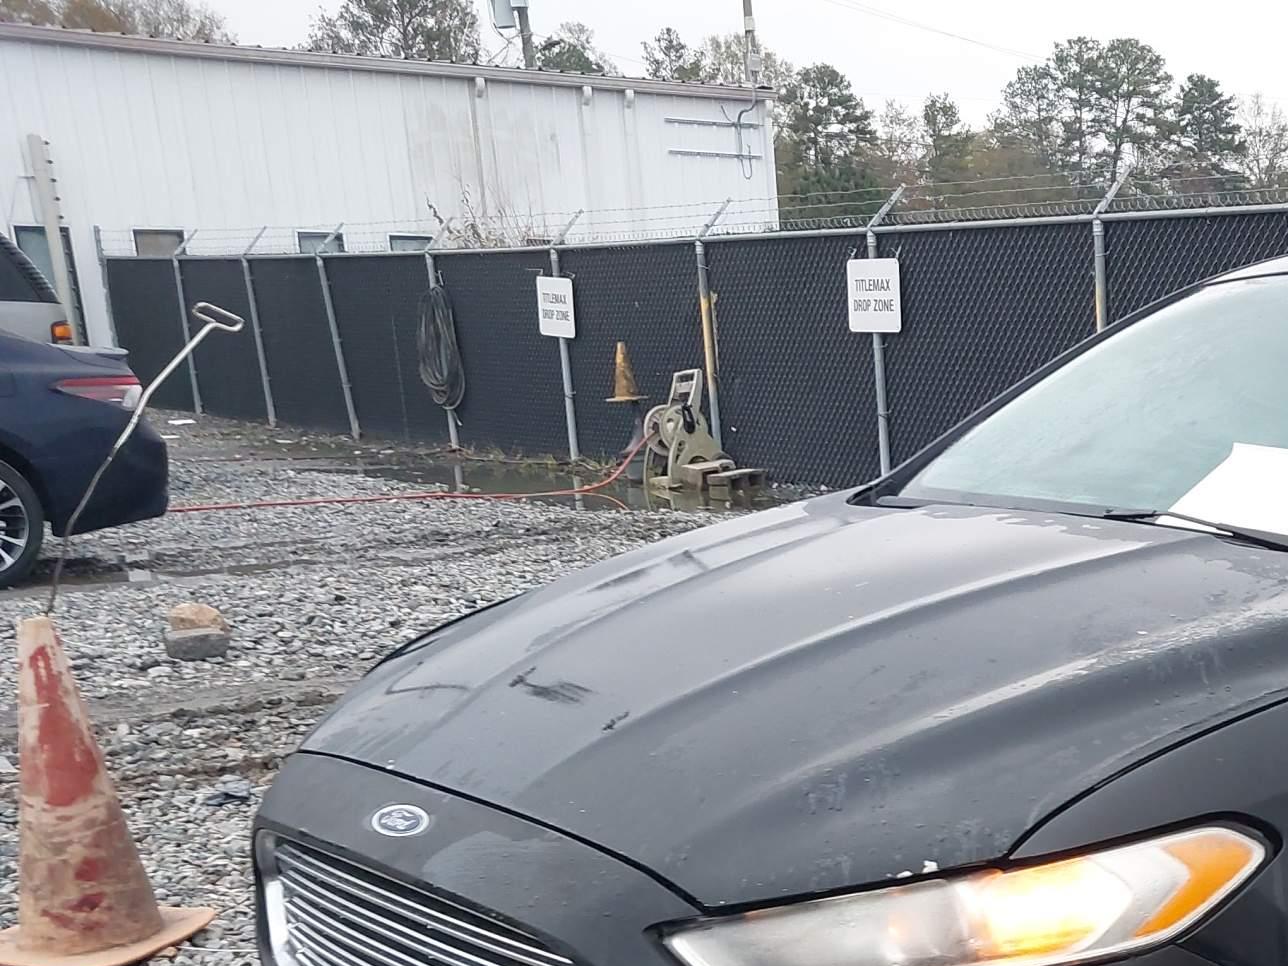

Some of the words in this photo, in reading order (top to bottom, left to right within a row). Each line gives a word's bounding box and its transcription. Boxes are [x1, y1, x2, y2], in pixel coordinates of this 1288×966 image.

[854, 278, 891, 291] TITLEMAX
[854, 299, 871, 312] DROP
[873, 299, 895, 312] ZONE
